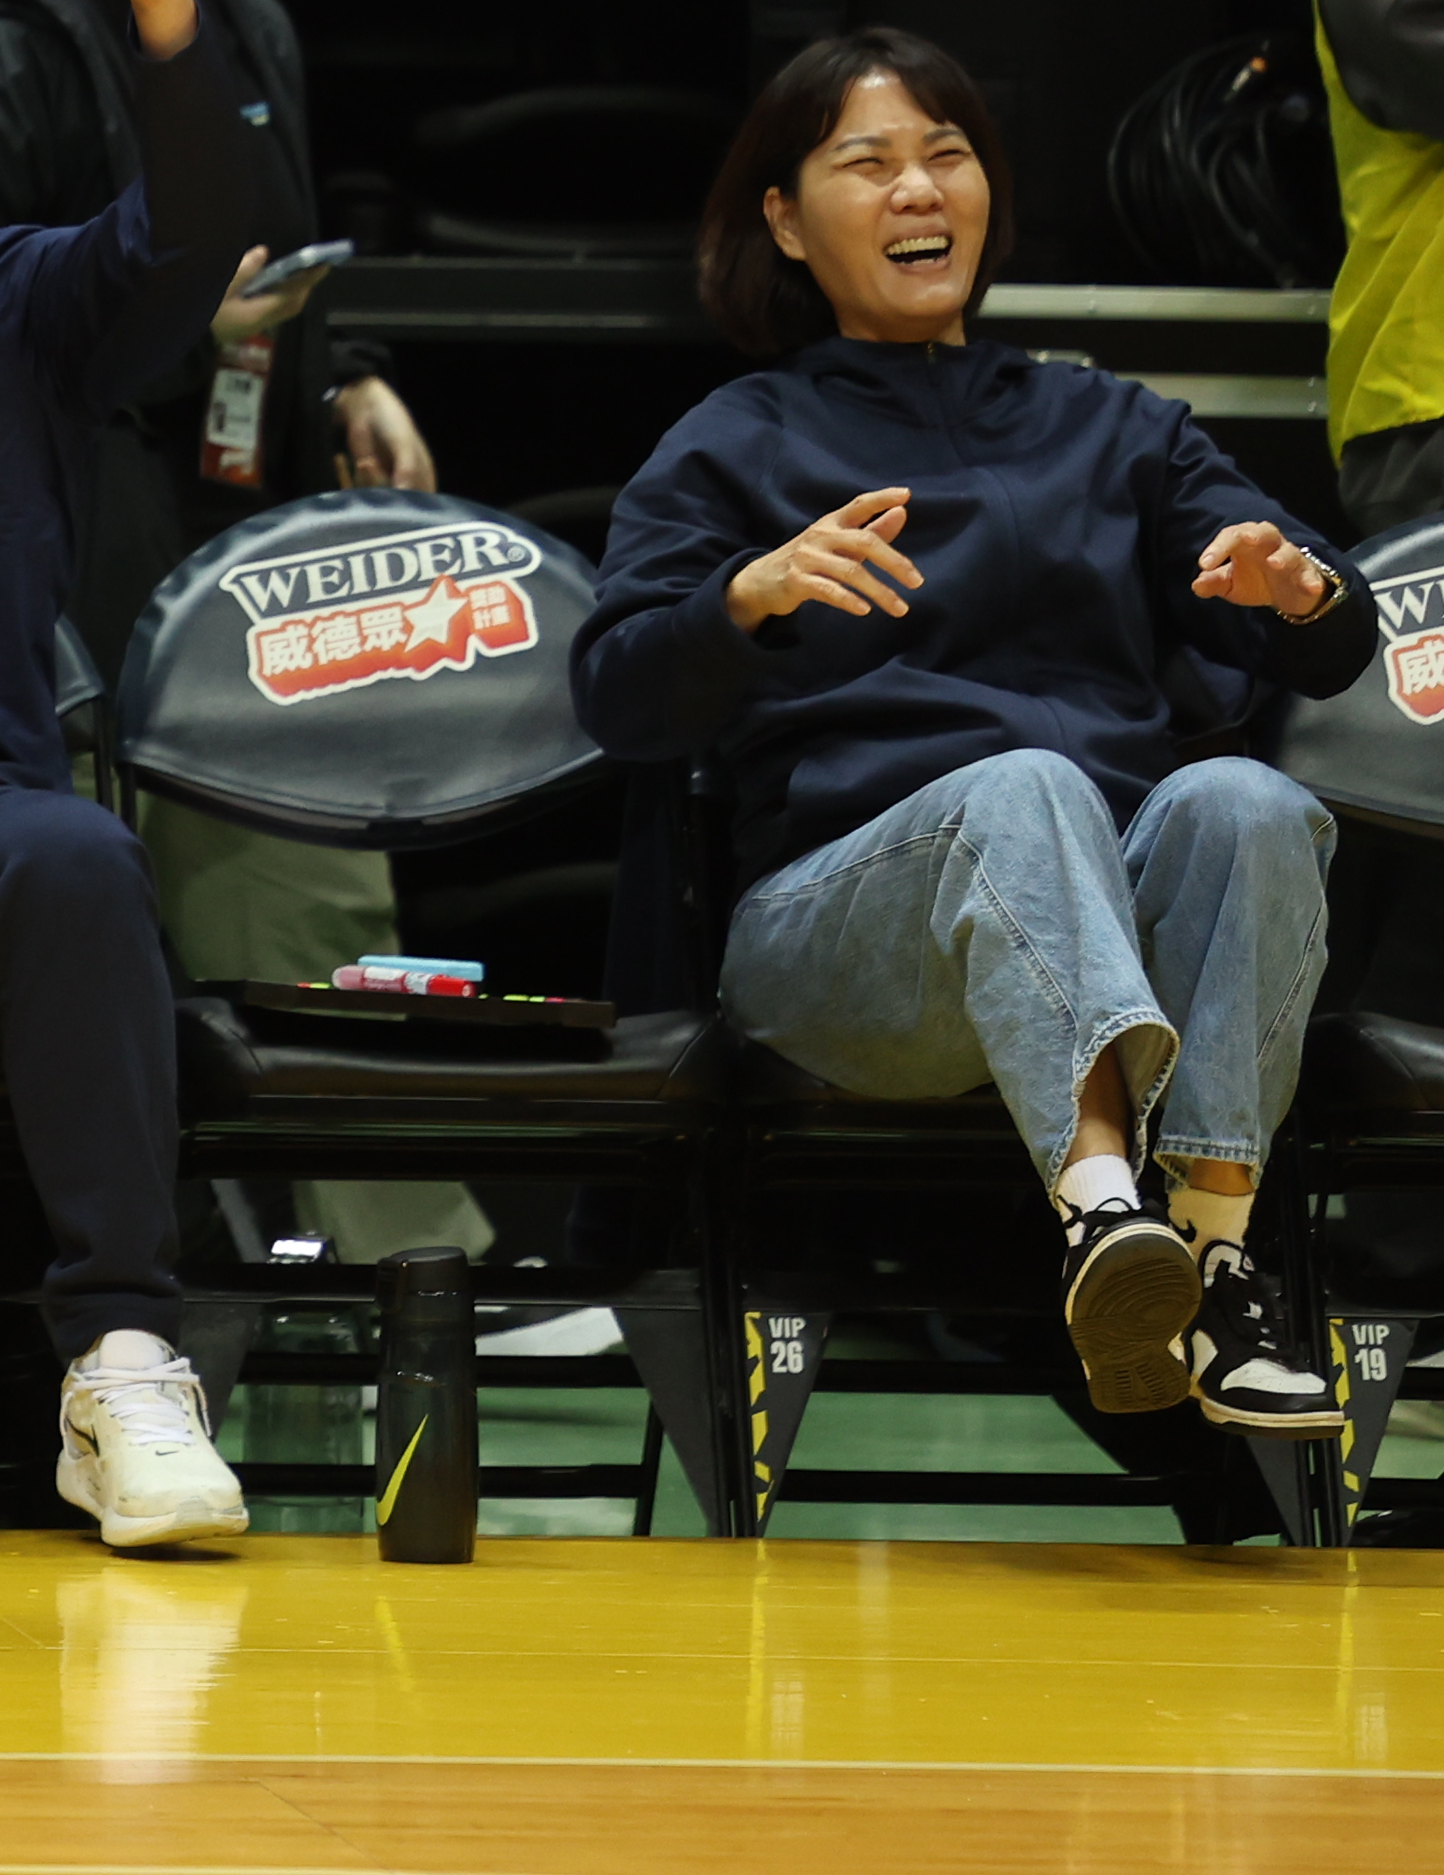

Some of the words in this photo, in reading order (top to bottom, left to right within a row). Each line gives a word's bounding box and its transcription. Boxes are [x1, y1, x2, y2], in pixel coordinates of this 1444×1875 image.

[240, 530, 510, 613] WEIDER
[258, 605, 408, 678] 威德眾
[768, 1317, 806, 1338] VIP
[1352, 1324, 1389, 1345] VIP
[770, 1341, 804, 1373] 26
[1354, 1348, 1386, 1381] 19
